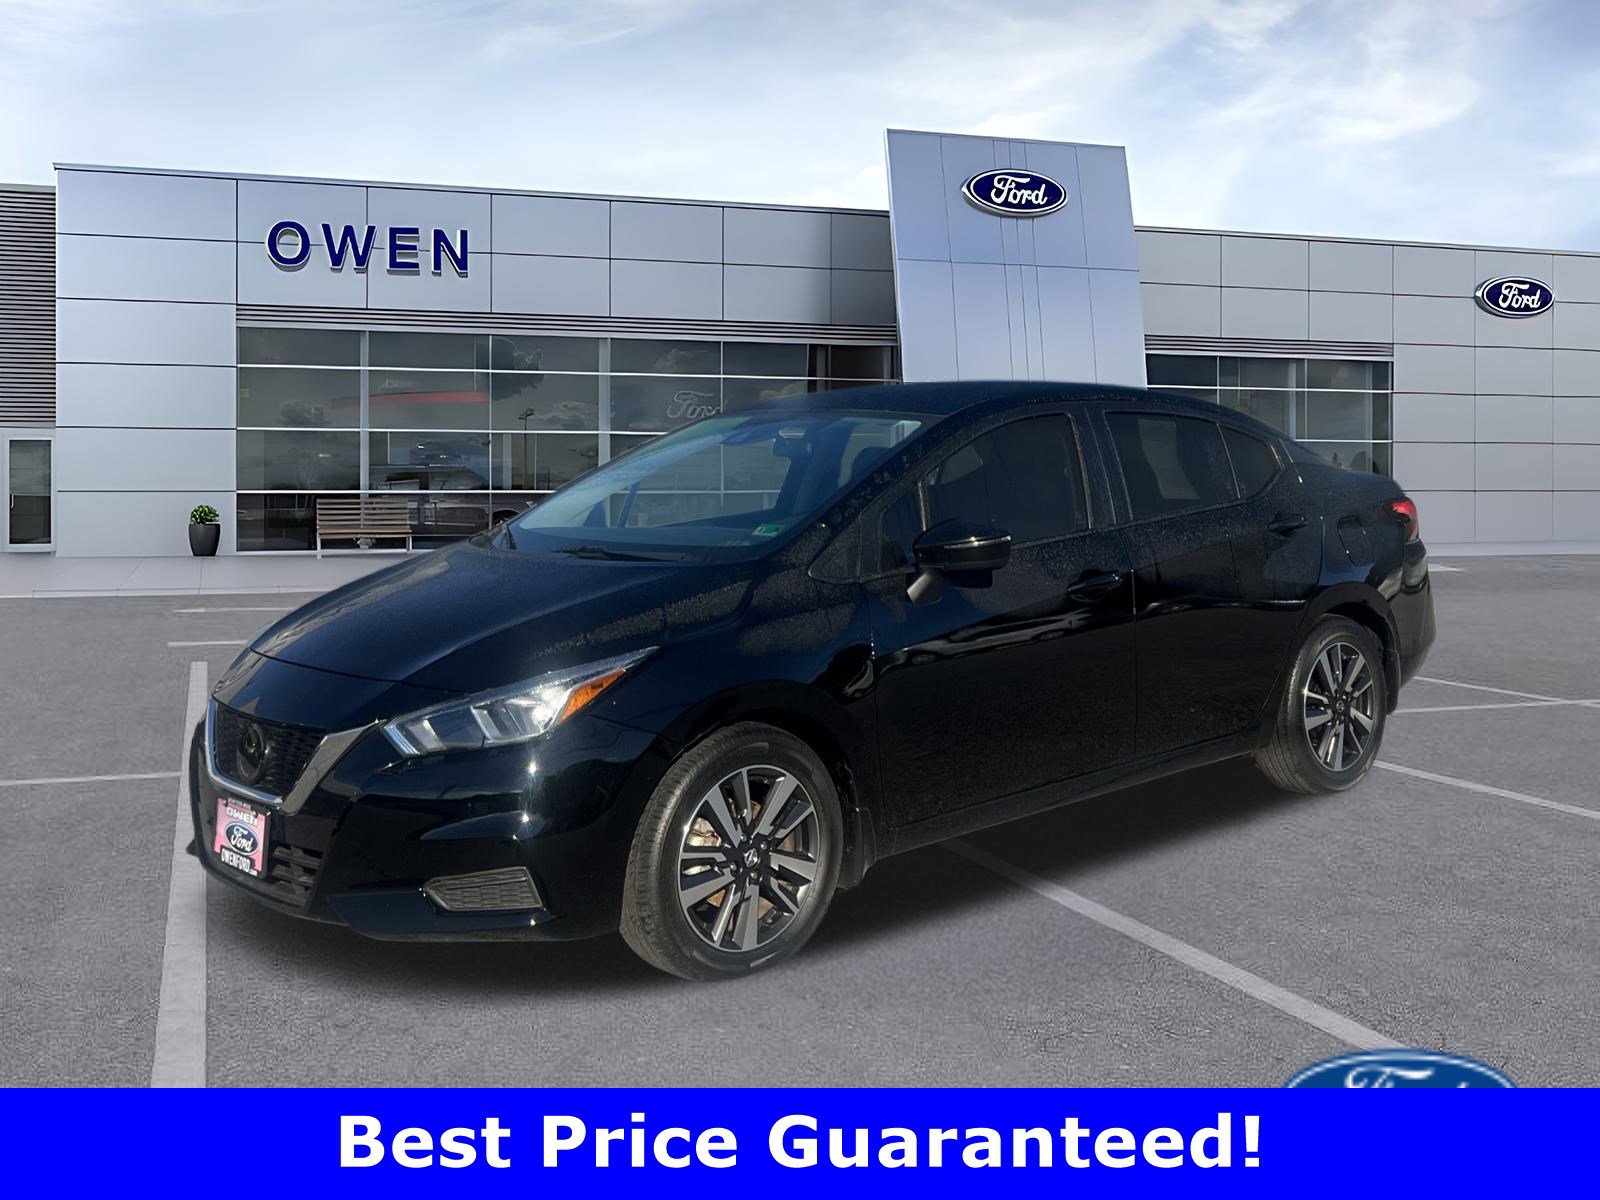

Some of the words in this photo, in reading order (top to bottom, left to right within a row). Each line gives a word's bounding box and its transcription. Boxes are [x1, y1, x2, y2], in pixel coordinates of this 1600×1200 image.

[991, 175, 1048, 205] Ford
[266, 220, 469, 275] OWEN
[1499, 283, 1541, 308] Ford
[231, 826, 254, 852] Ford
